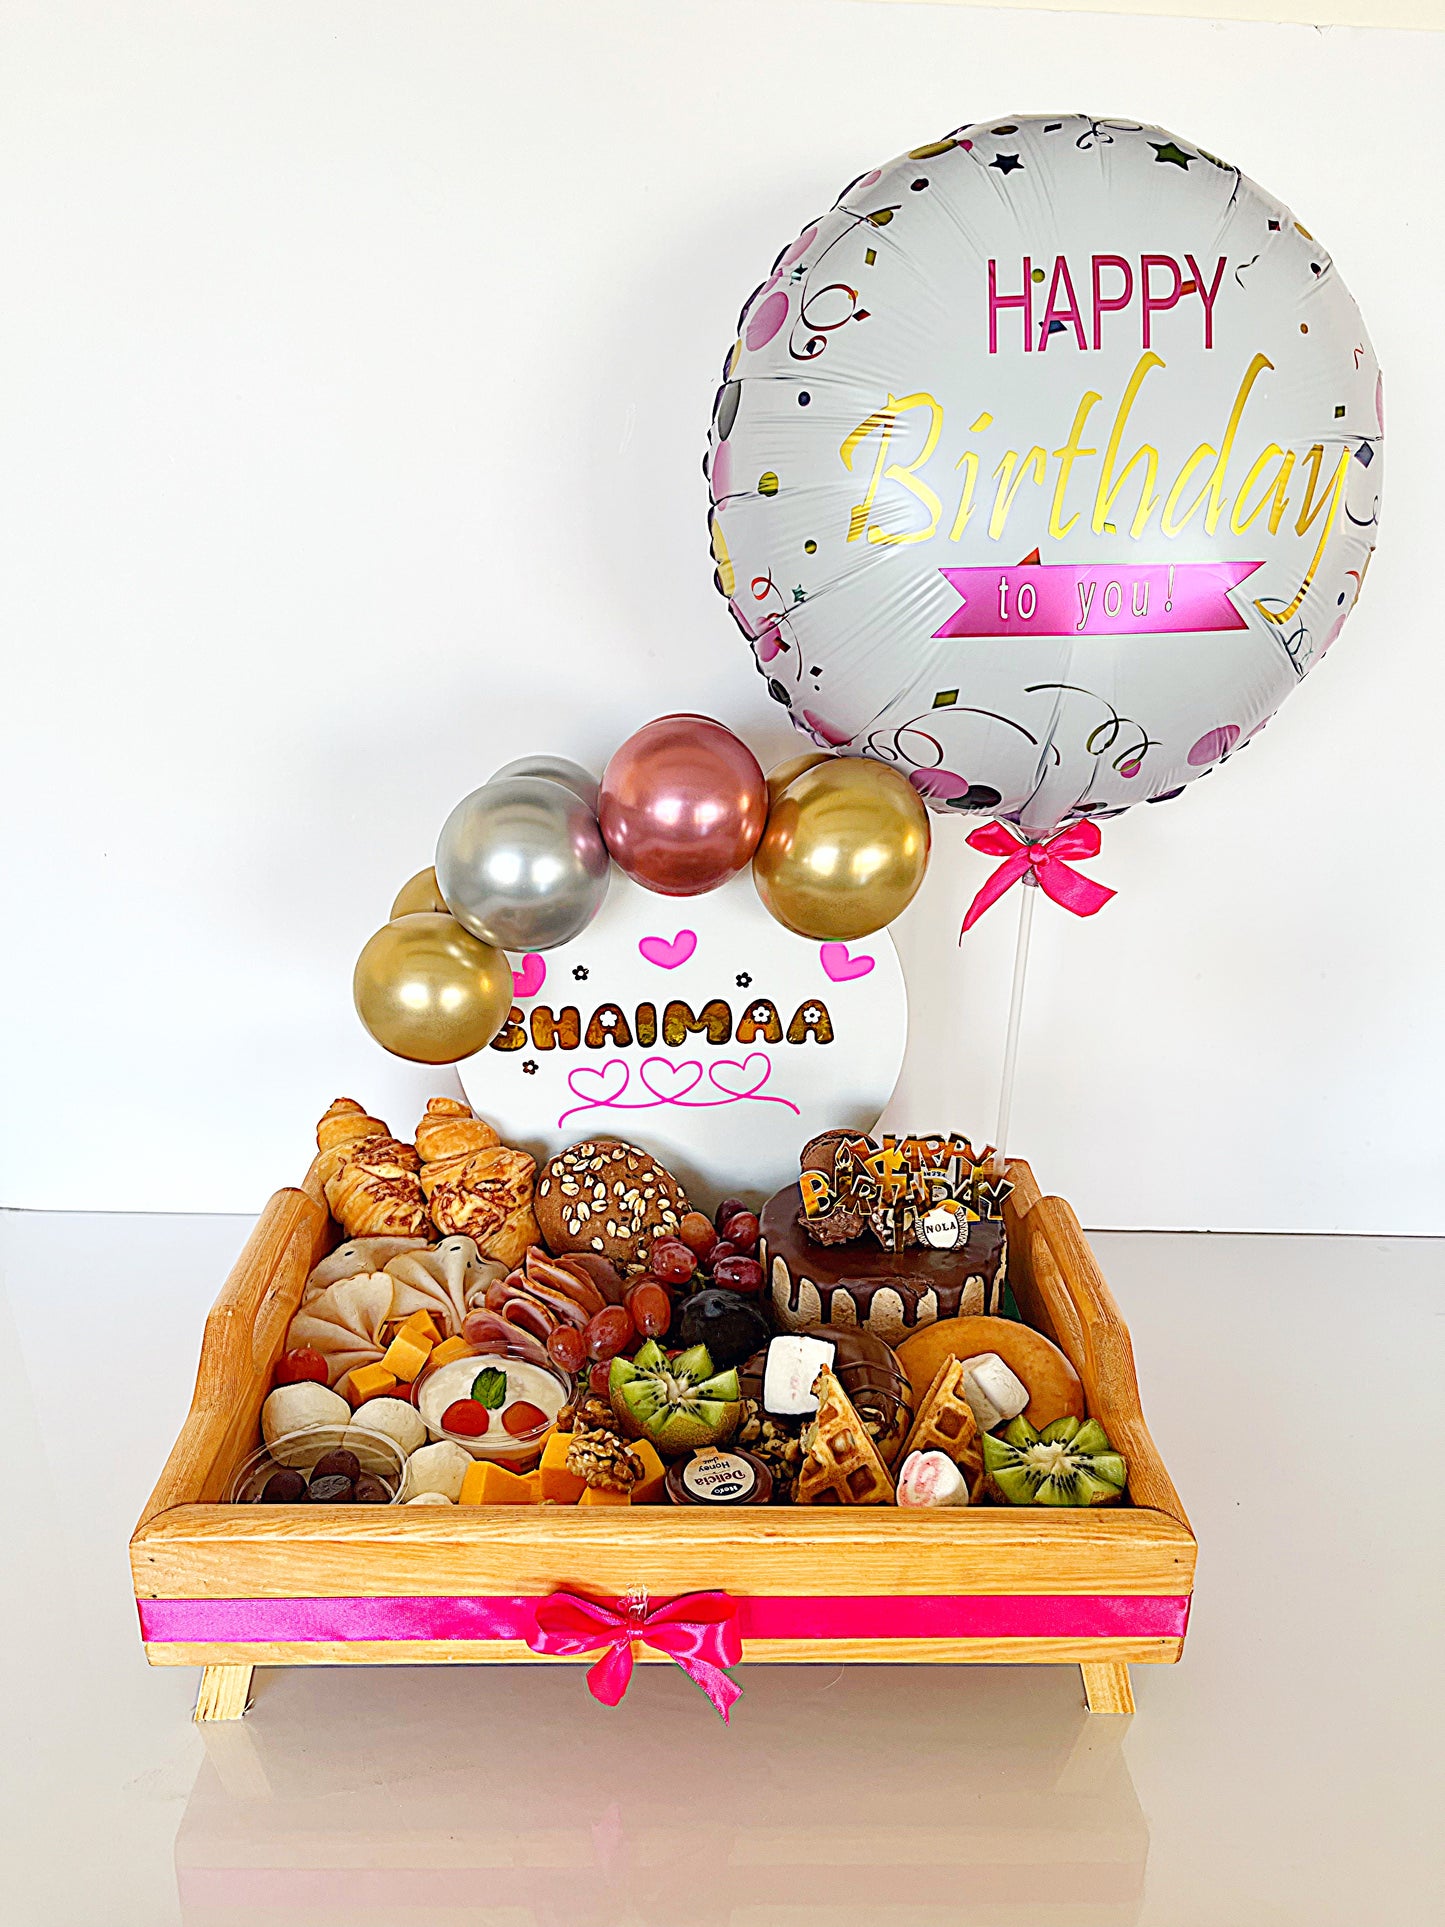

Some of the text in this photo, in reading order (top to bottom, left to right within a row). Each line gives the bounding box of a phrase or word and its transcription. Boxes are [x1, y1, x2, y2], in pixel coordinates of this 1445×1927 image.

[987, 254, 1228, 354] HAPPY
[839, 351, 1352, 624] Birthday
[998, 564, 1177, 631] to you!
[489, 998, 835, 1053] SHAIMAA
[846, 1130, 998, 1180] HAPPY
[925, 1222, 957, 1235] NOLA
[695, 1470, 745, 1485] Delicia
[698, 1461, 730, 1472] Honey
[714, 1485, 738, 1494] Hero
